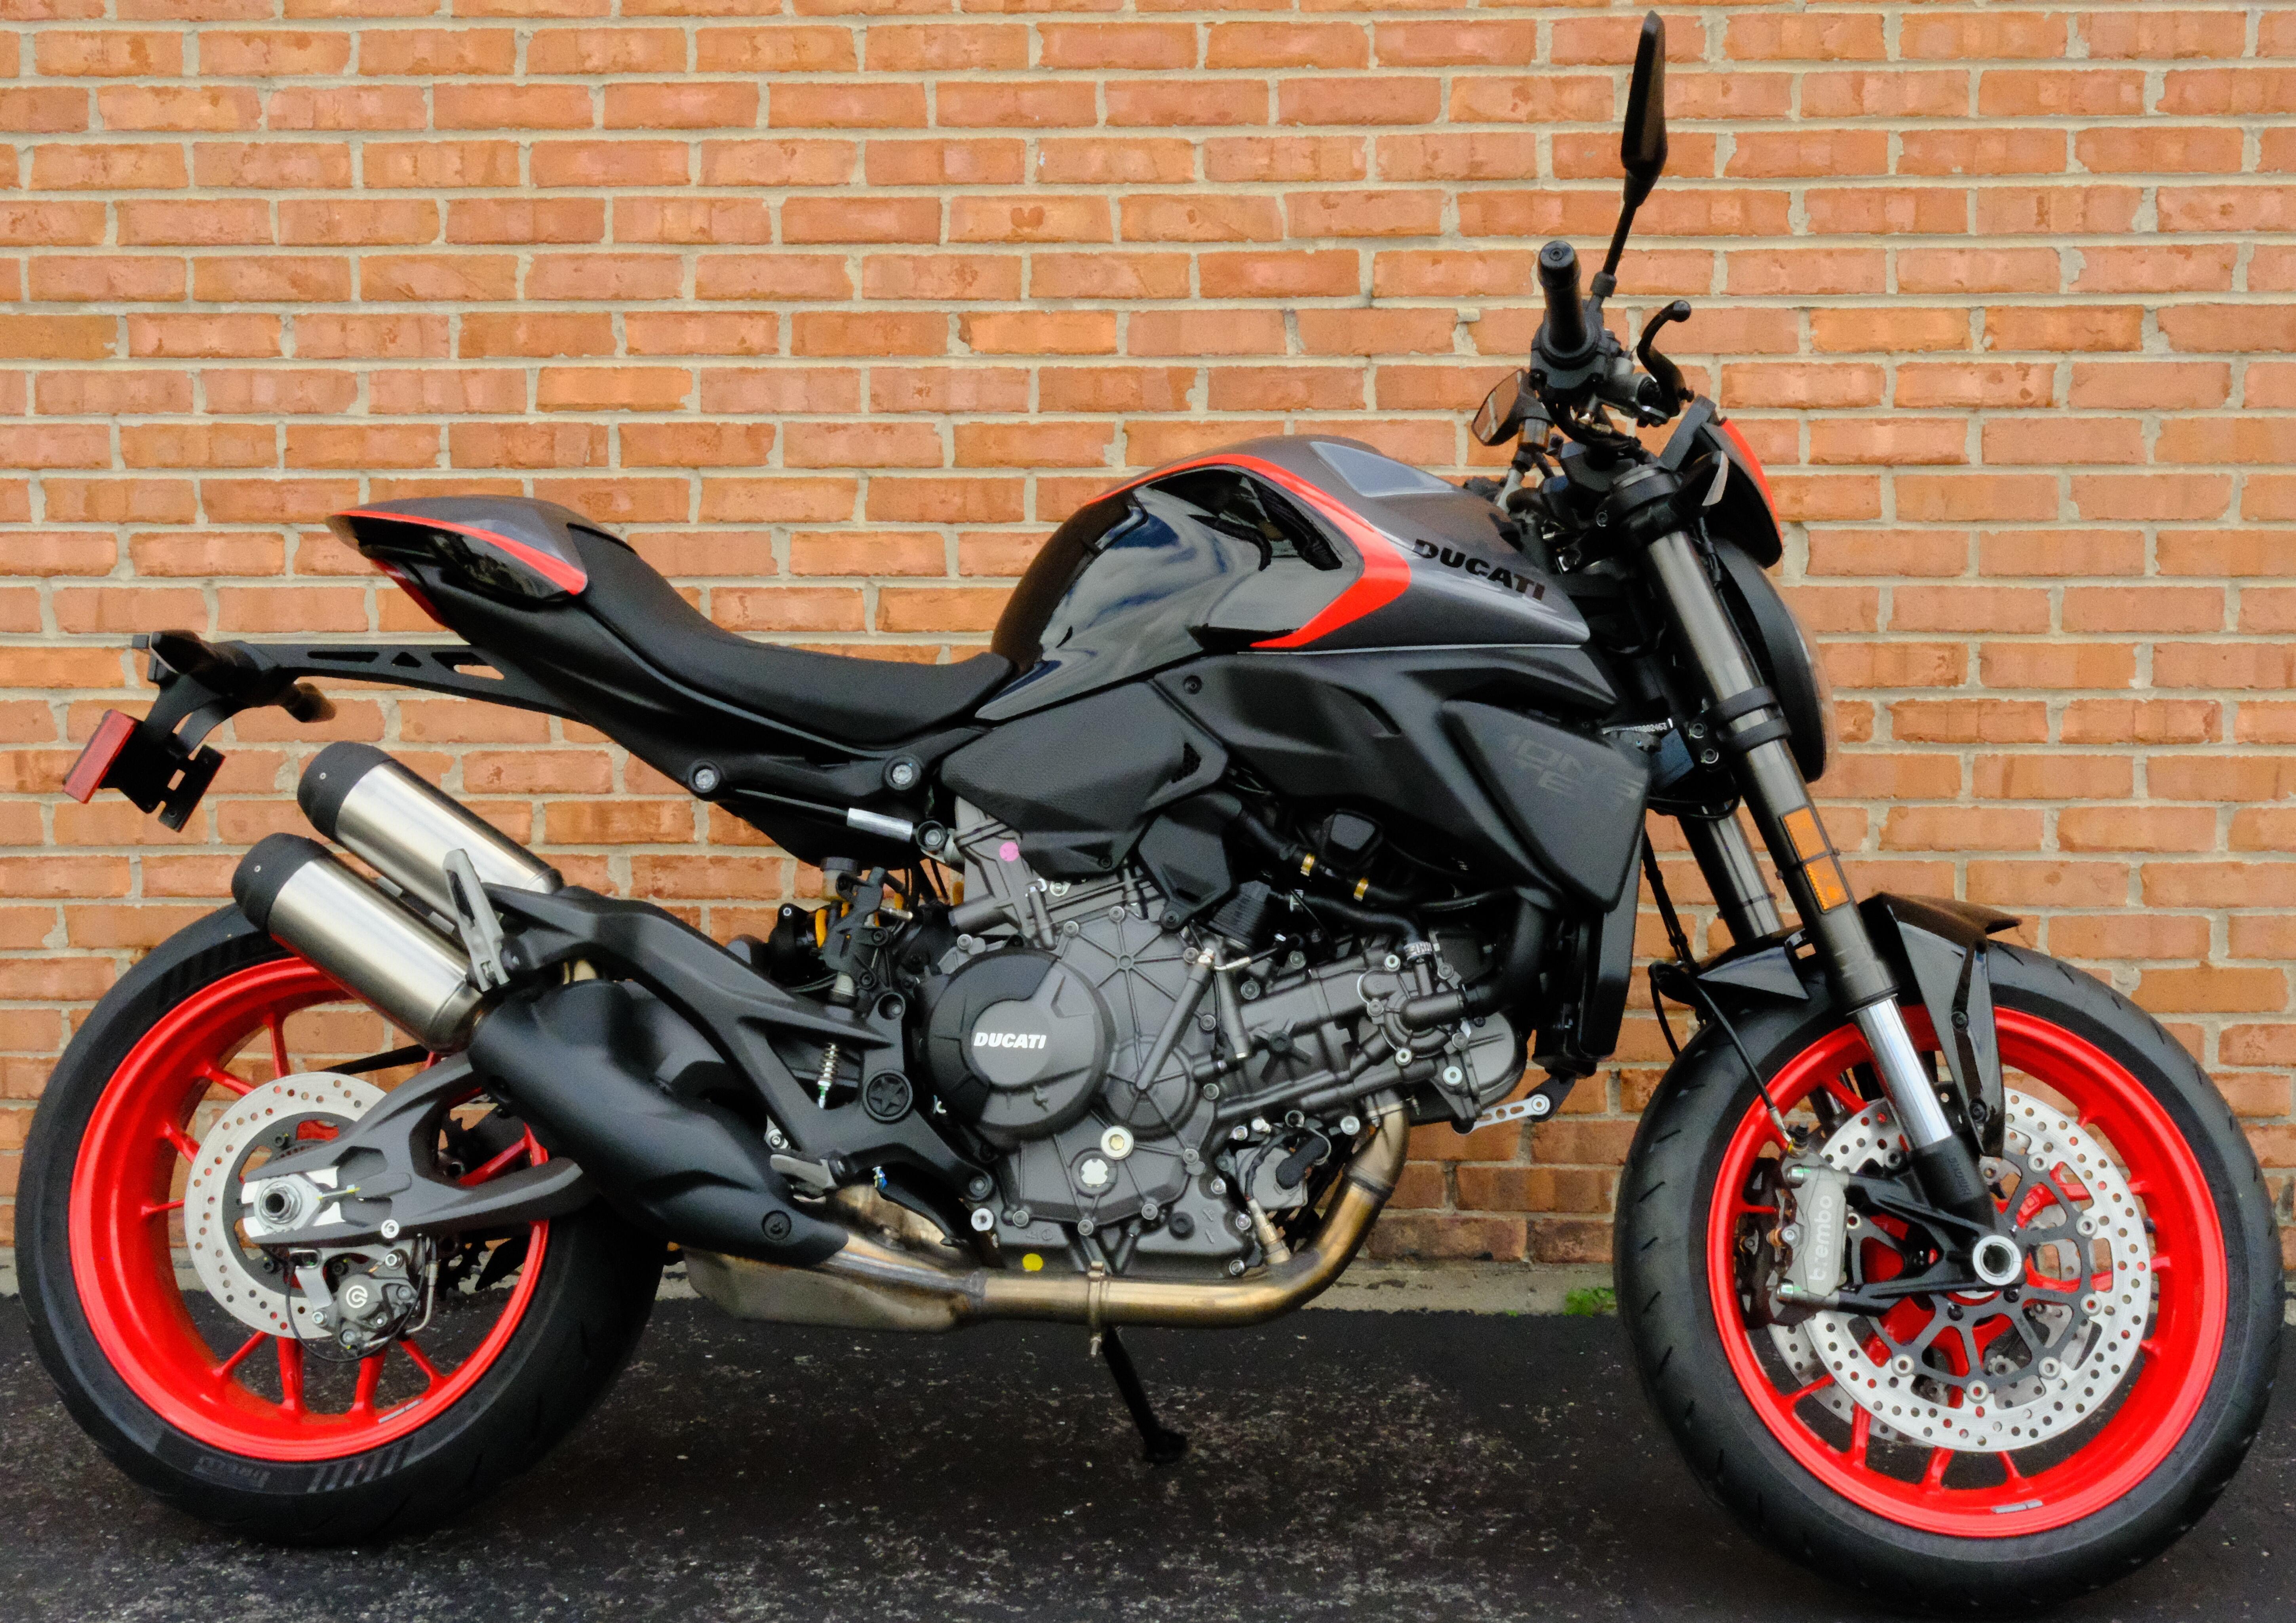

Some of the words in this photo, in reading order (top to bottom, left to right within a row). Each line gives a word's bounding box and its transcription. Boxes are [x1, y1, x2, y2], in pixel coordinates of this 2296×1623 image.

[1412, 539, 1545, 601] DUCATI
[974, 1032, 1046, 1049] DUCATI
[1810, 1196, 1832, 1281] brembo
